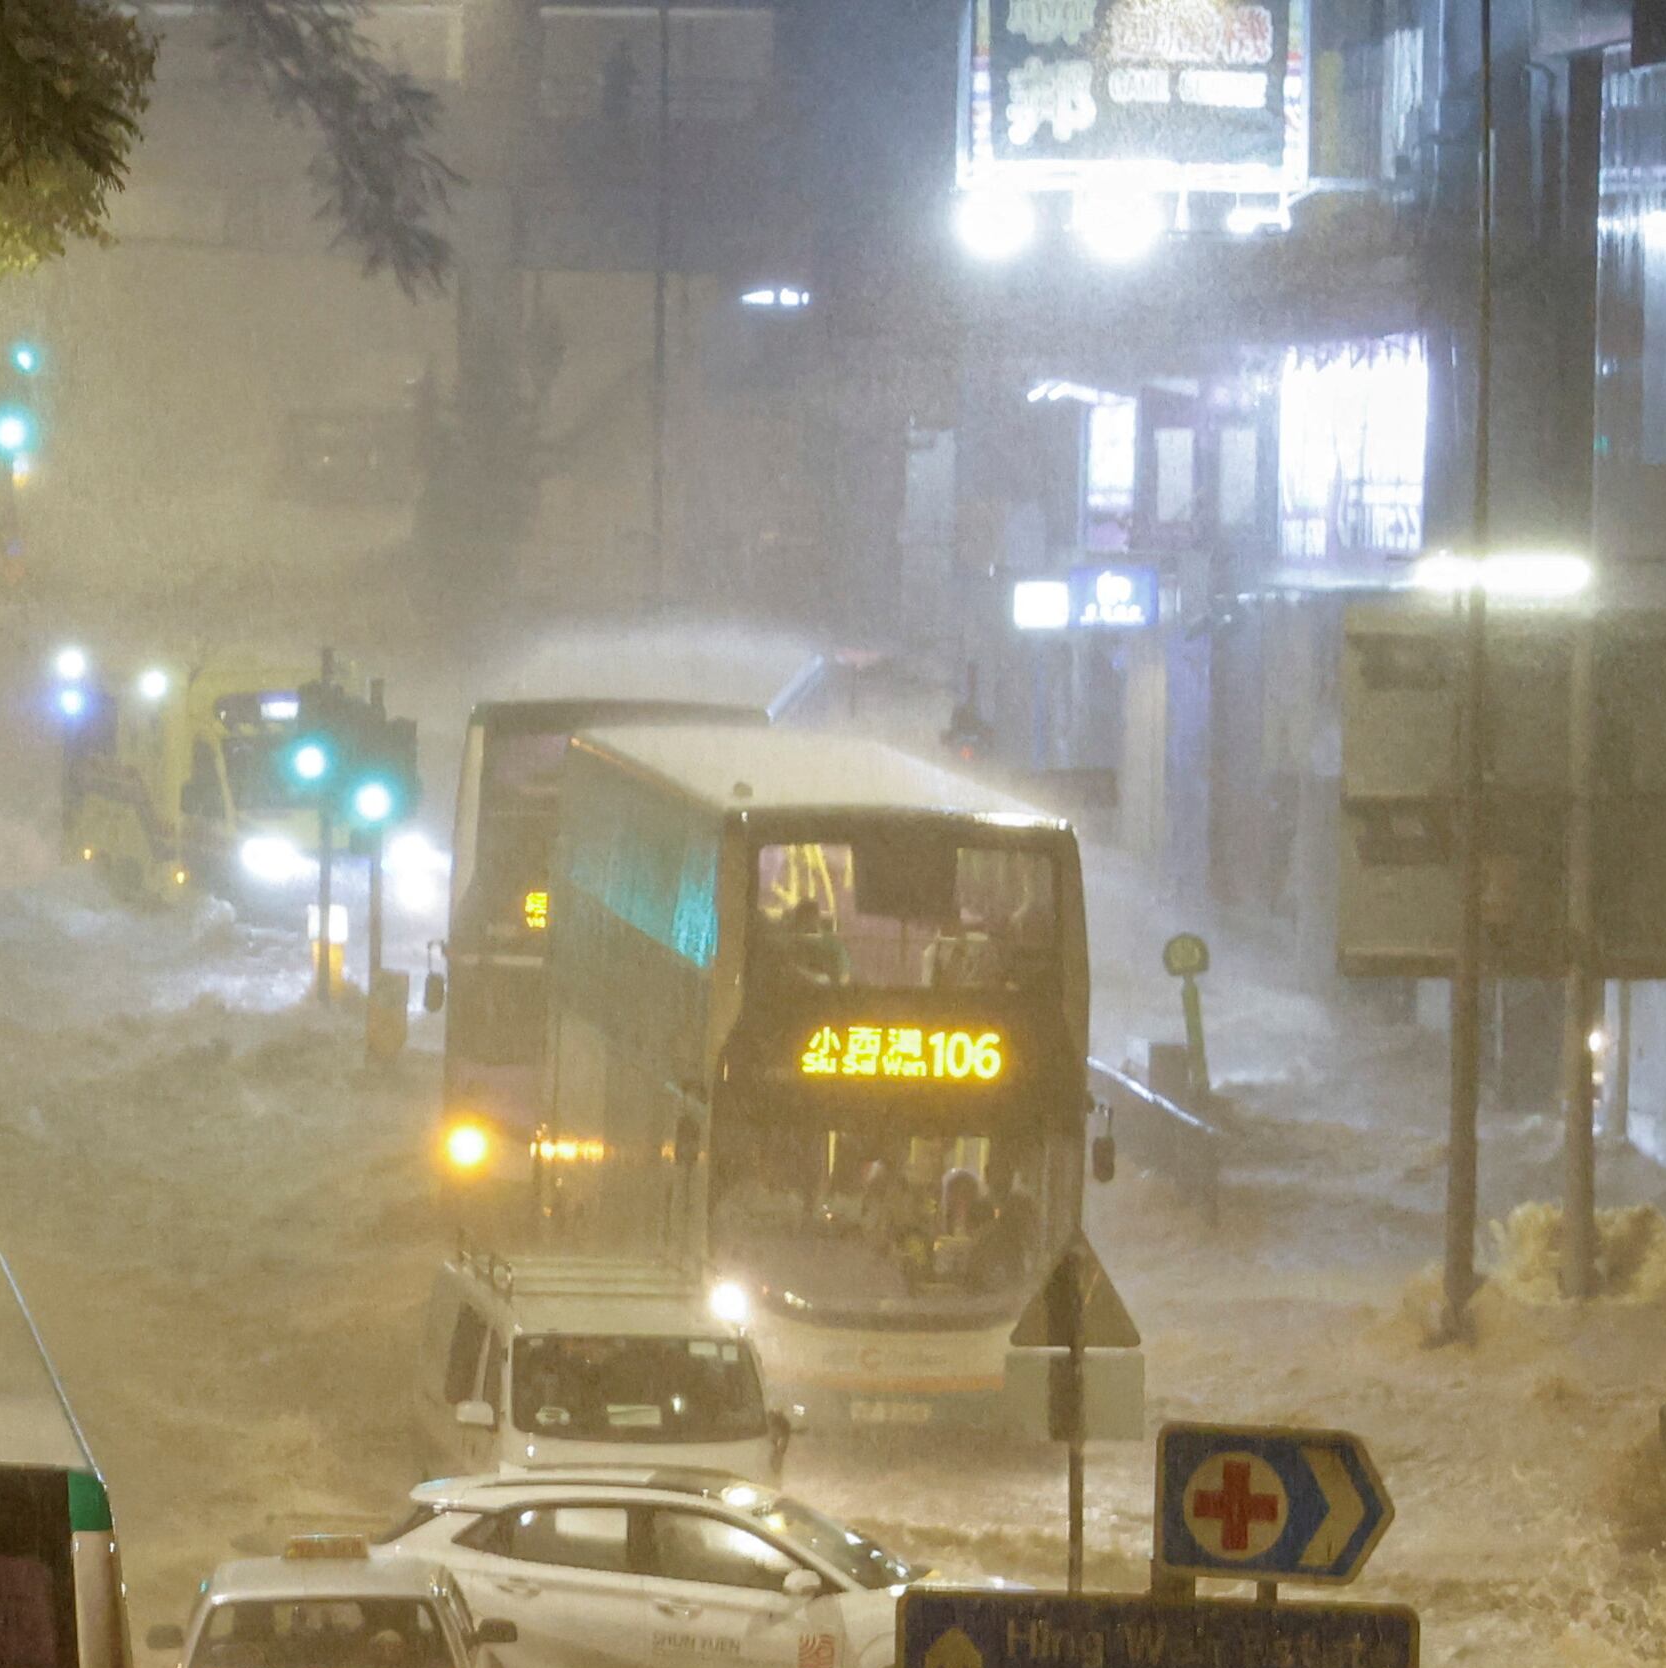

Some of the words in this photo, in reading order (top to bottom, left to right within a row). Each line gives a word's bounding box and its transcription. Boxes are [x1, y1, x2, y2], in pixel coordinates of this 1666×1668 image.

[808, 1026, 923, 1057] 小西灣
[929, 1031, 1001, 1079] 106
[882, 1055, 927, 1077] Wan
